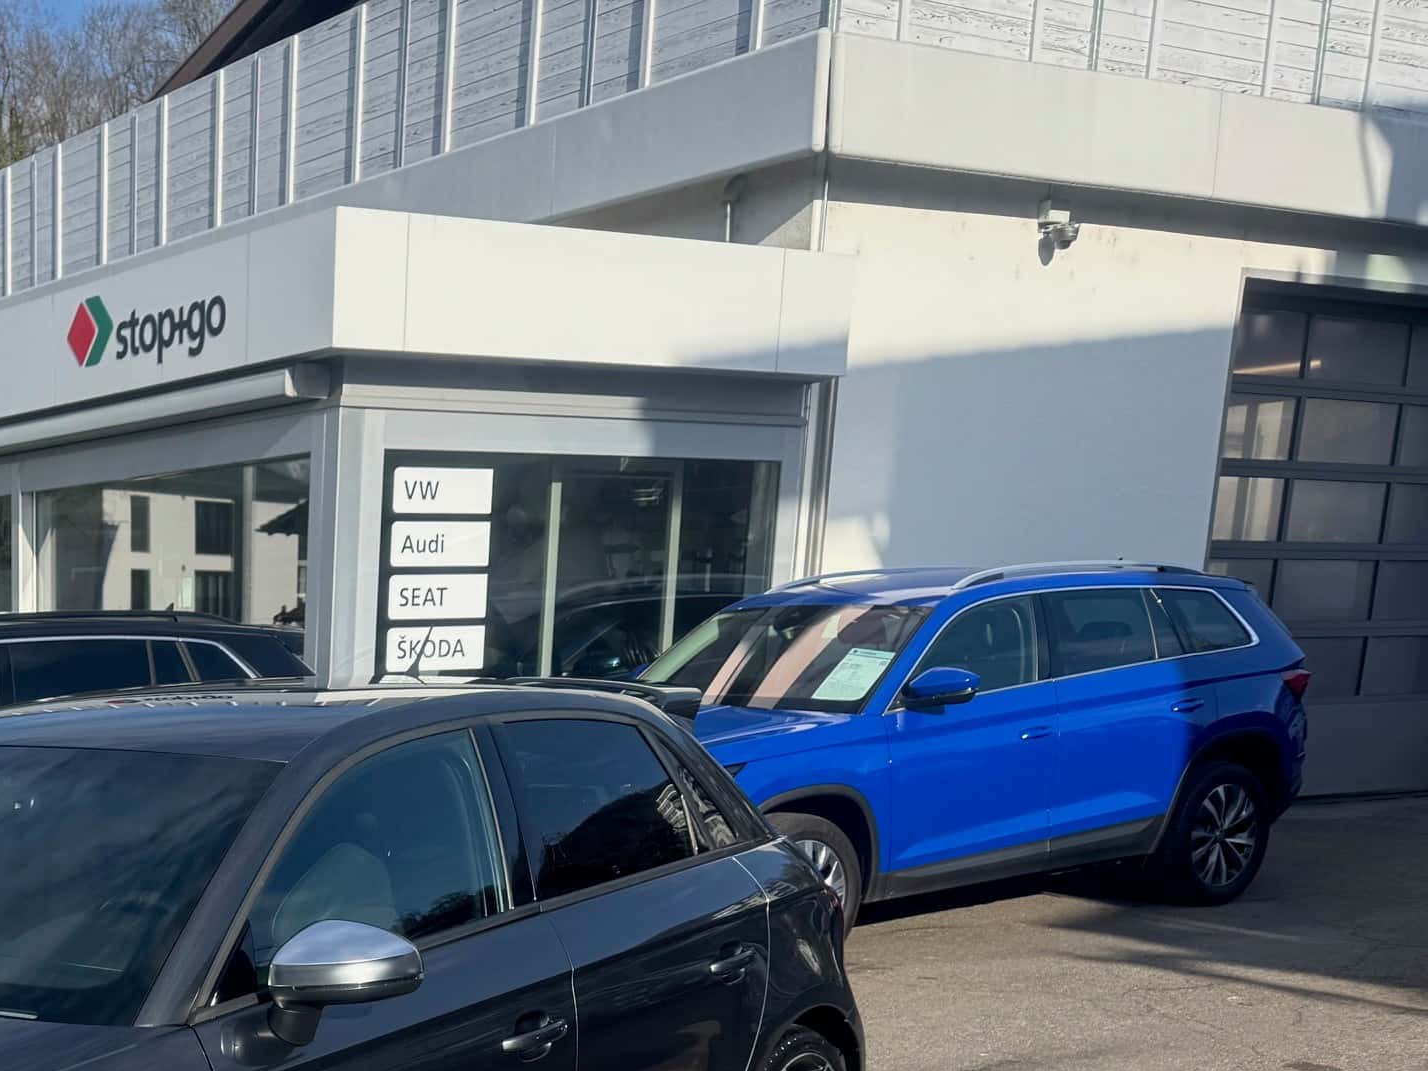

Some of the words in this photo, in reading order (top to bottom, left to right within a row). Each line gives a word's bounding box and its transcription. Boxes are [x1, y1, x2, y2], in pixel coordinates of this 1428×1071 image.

[116, 295, 226, 364] stop+go
[404, 480, 440, 500] VW
[401, 534, 445, 553] Audi
[399, 587, 448, 606] SEAT
[397, 635, 465, 659] ŠKODA
